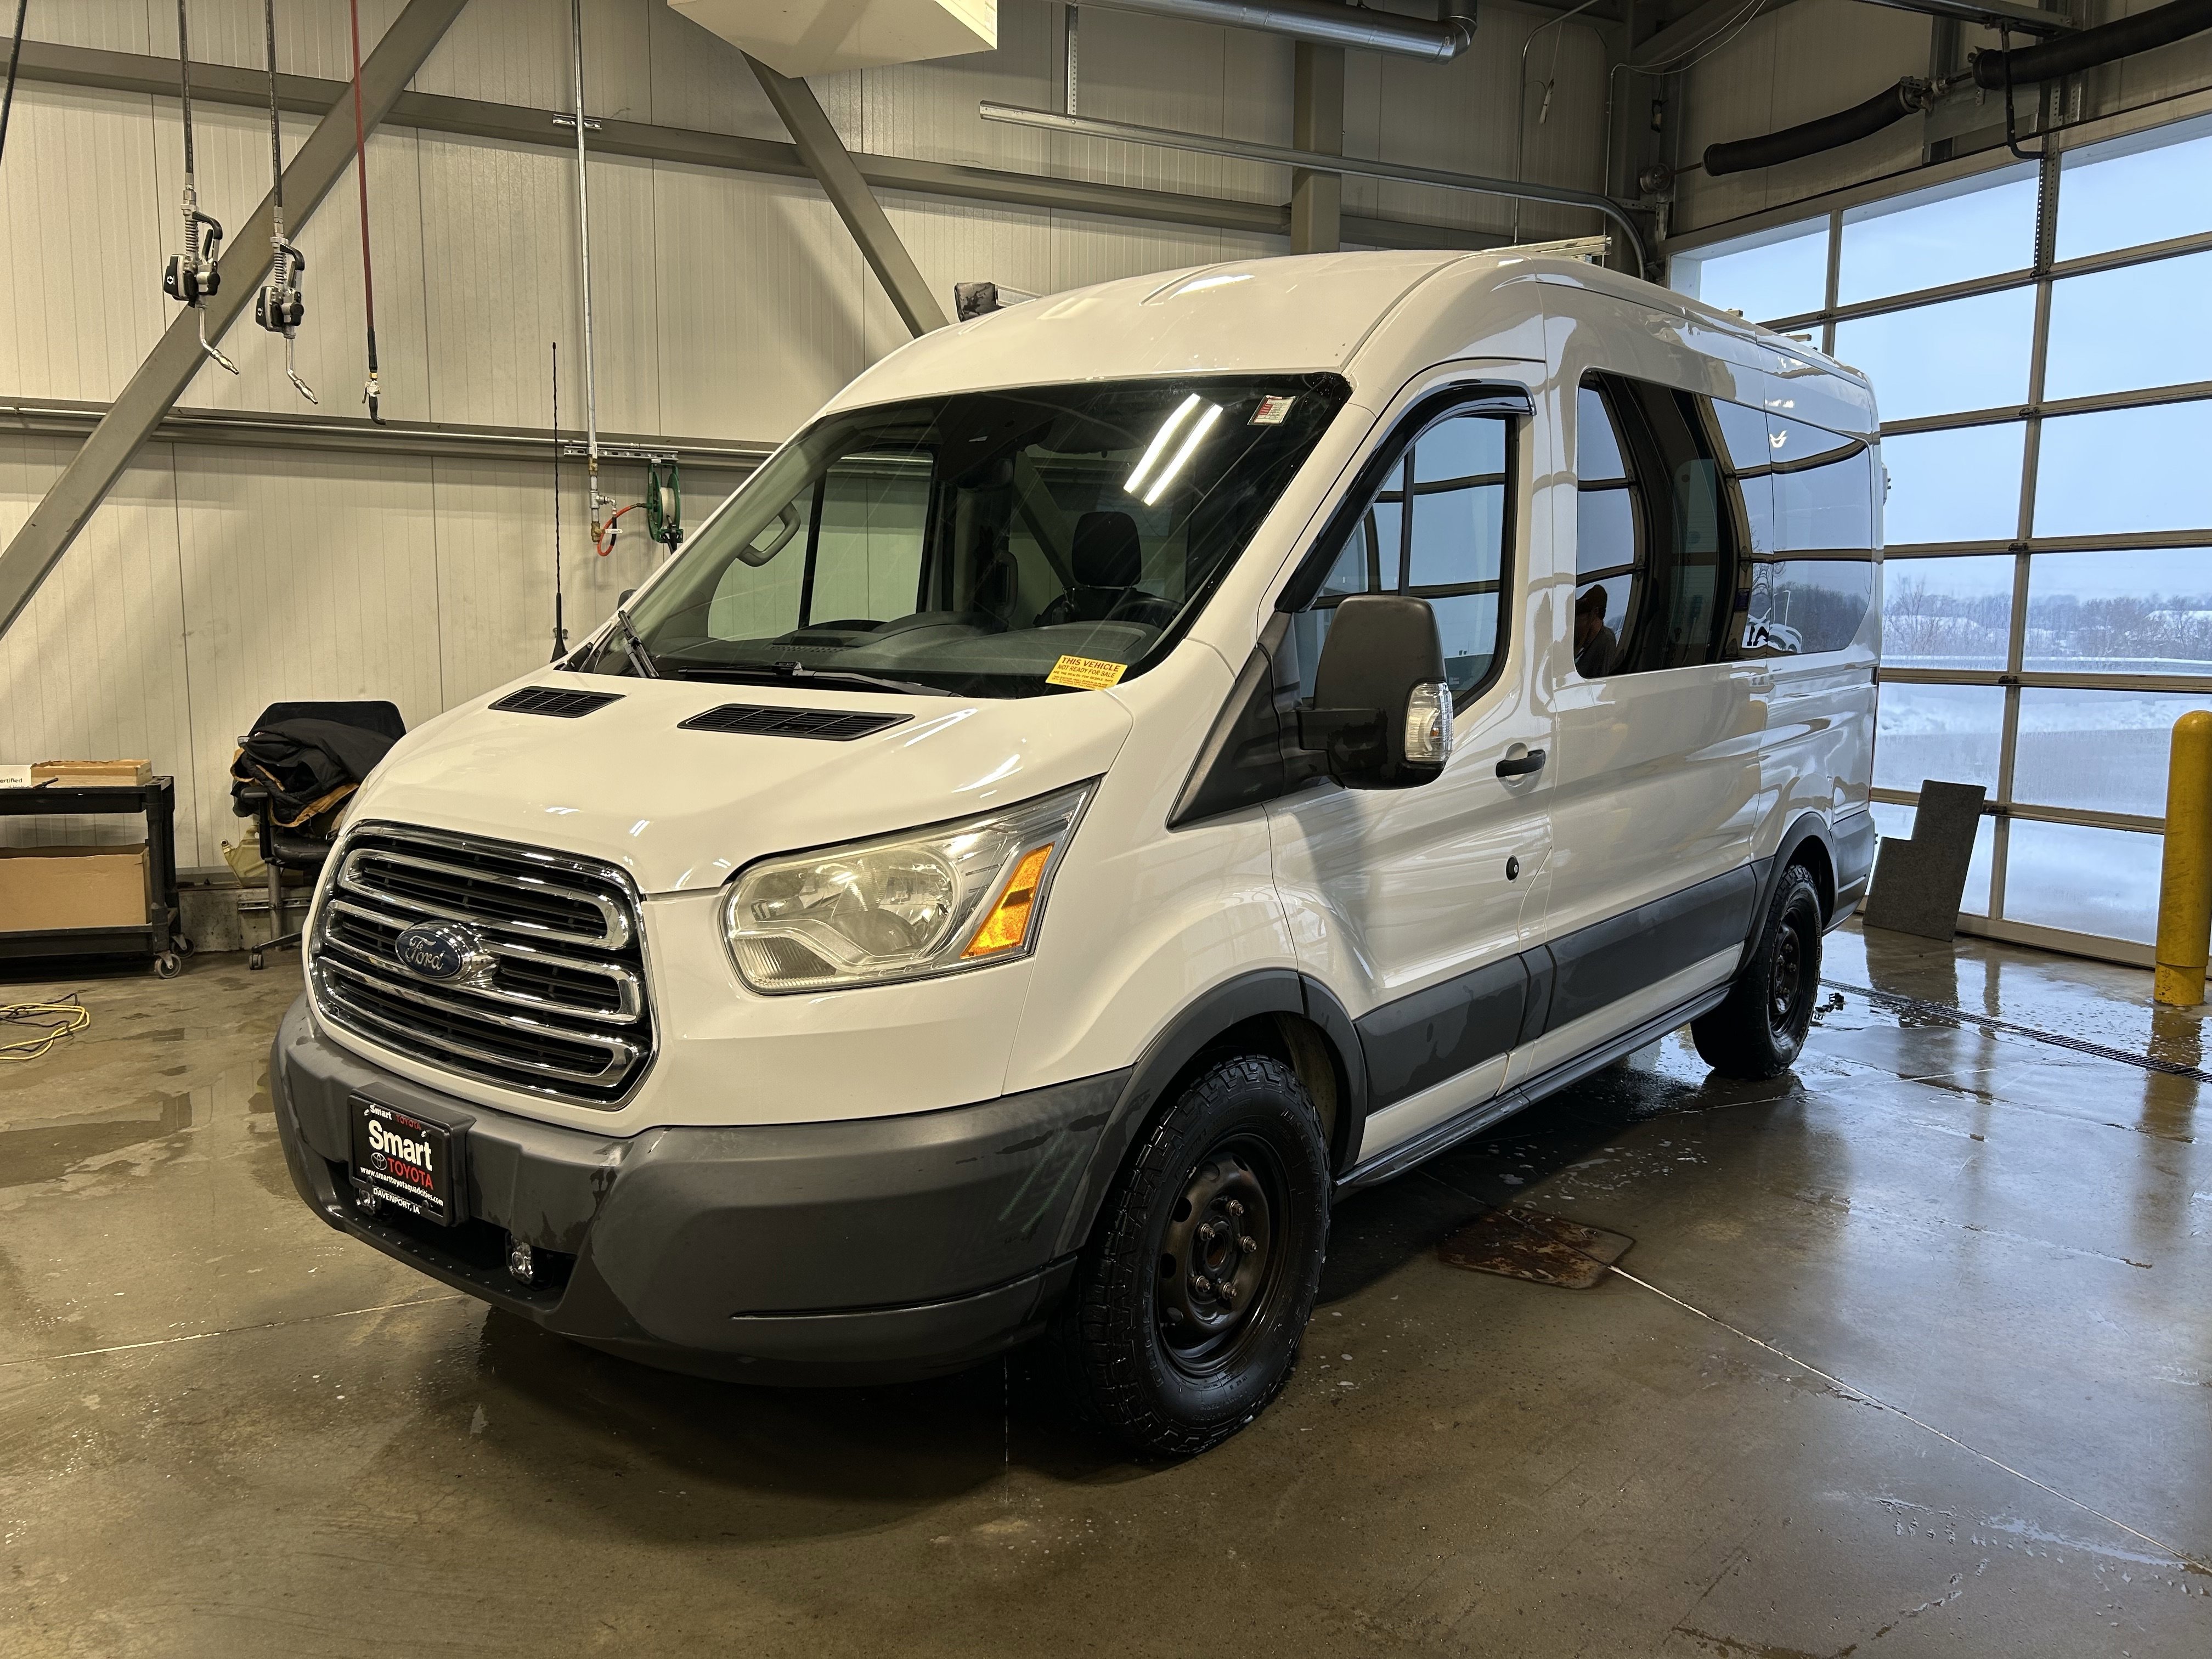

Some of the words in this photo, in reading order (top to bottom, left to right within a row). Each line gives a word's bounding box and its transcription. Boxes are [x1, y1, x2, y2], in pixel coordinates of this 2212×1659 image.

[1062, 657, 1081, 665] THIS
[1084, 660, 1121, 672] VEHICLE
[405, 935, 445, 970] Ford
[370, 1103, 392, 1120] Smart
[396, 1114, 421, 1131] TOYOTA
[369, 1120, 432, 1171] Smart
[360, 1166, 443, 1206] www.smarttoyotaquadcities.com
[387, 1157, 433, 1190] TOYOTA
[373, 1187, 411, 1211] DAVENPORT,
[413, 1206, 420, 1214] IA
